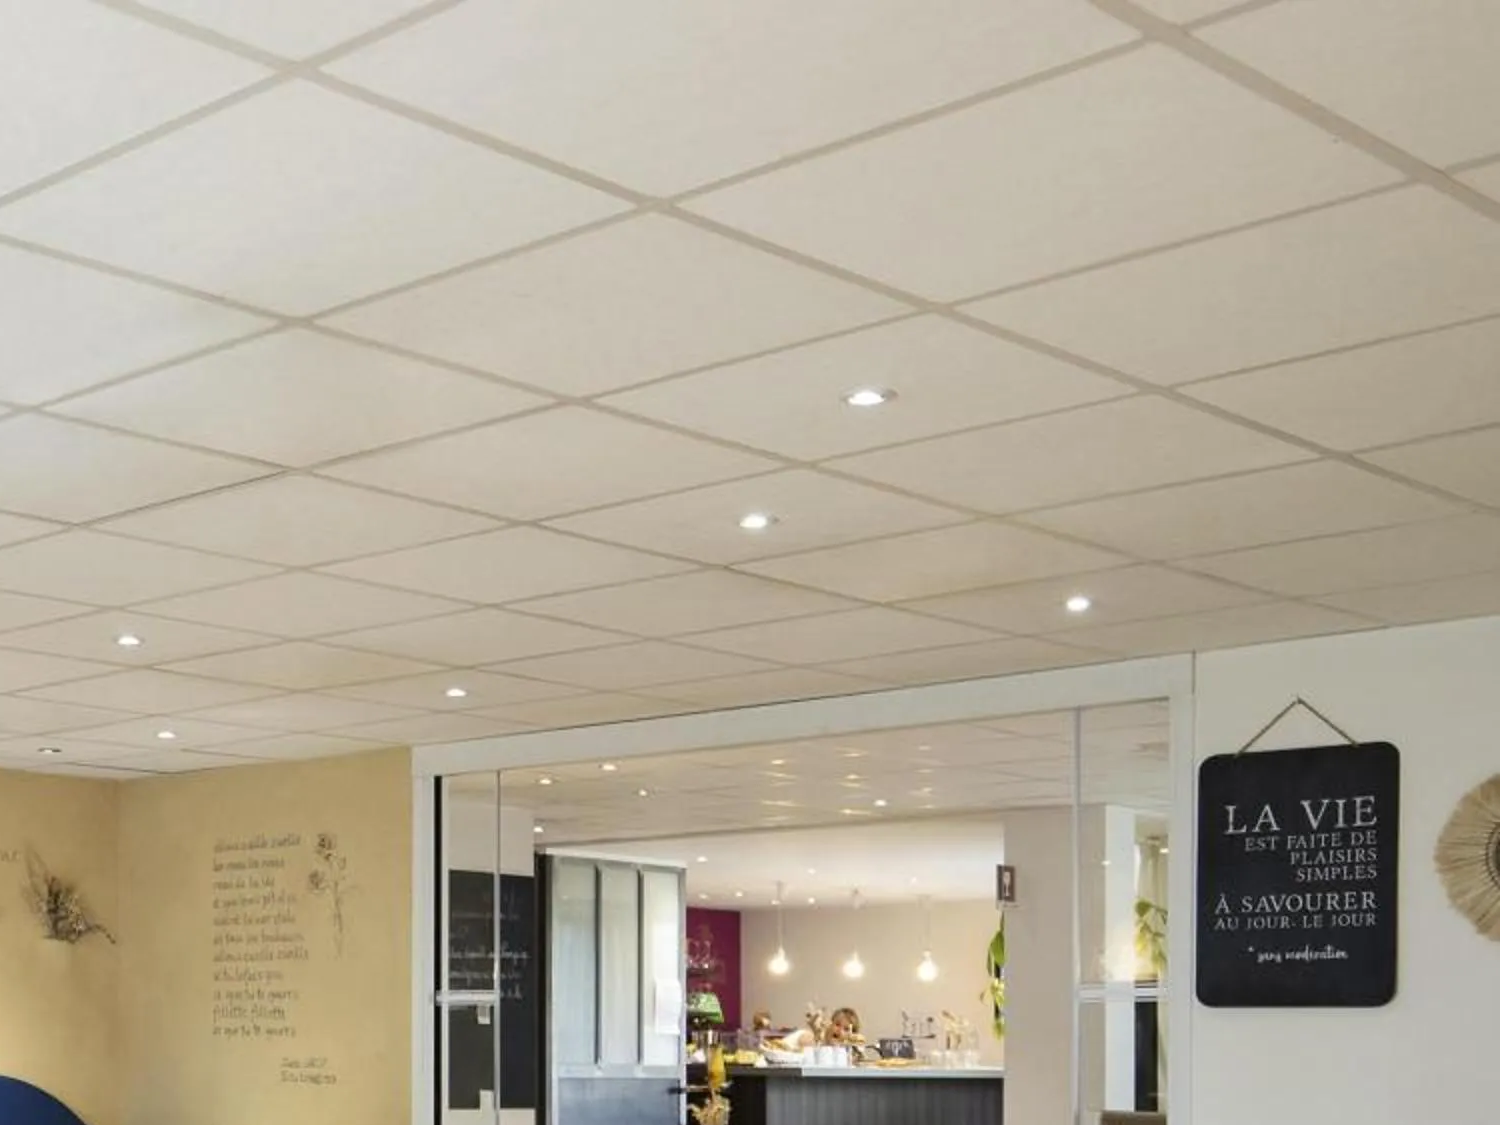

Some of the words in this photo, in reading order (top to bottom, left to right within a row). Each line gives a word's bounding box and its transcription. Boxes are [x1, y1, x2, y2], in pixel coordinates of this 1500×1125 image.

[1223, 803, 1281, 835] LA
[1300, 795, 1377, 831] VIE
[1244, 835, 1279, 852] EST
[1287, 832, 1342, 850] FAITE
[1350, 829, 1377, 846] DE
[1290, 847, 1377, 866] PLAISIRS
[1295, 864, 1378, 882] SIMPLES
[1241, 890, 1377, 913] SAVOURER
[1214, 916, 1239, 931] AU
[1303, 914, 1328, 929] LE
[1331, 911, 1376, 928] JOUR
